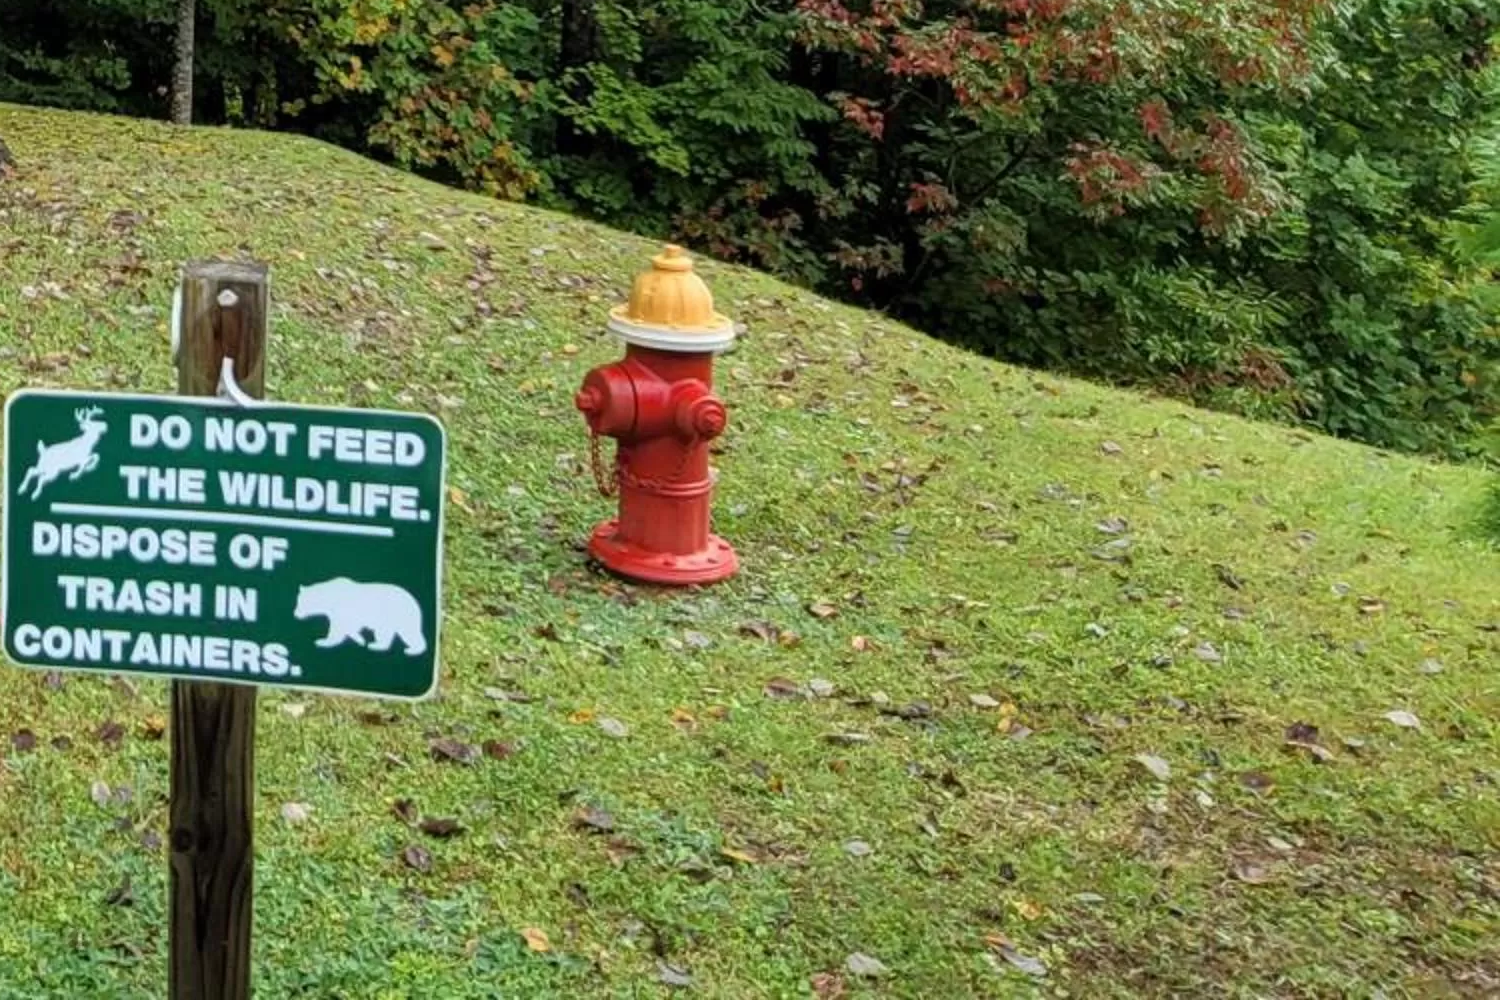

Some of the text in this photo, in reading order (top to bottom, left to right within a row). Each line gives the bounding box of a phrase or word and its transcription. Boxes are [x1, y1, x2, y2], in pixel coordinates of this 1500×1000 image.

[131, 414, 425, 466] DO NOT FEED
[120, 466, 430, 521] THE WILDLIFE.
[33, 522, 288, 570] DISPOSE OF
[58, 576, 257, 621] TRASH IN
[14, 624, 301, 676] CONTAINERS.
